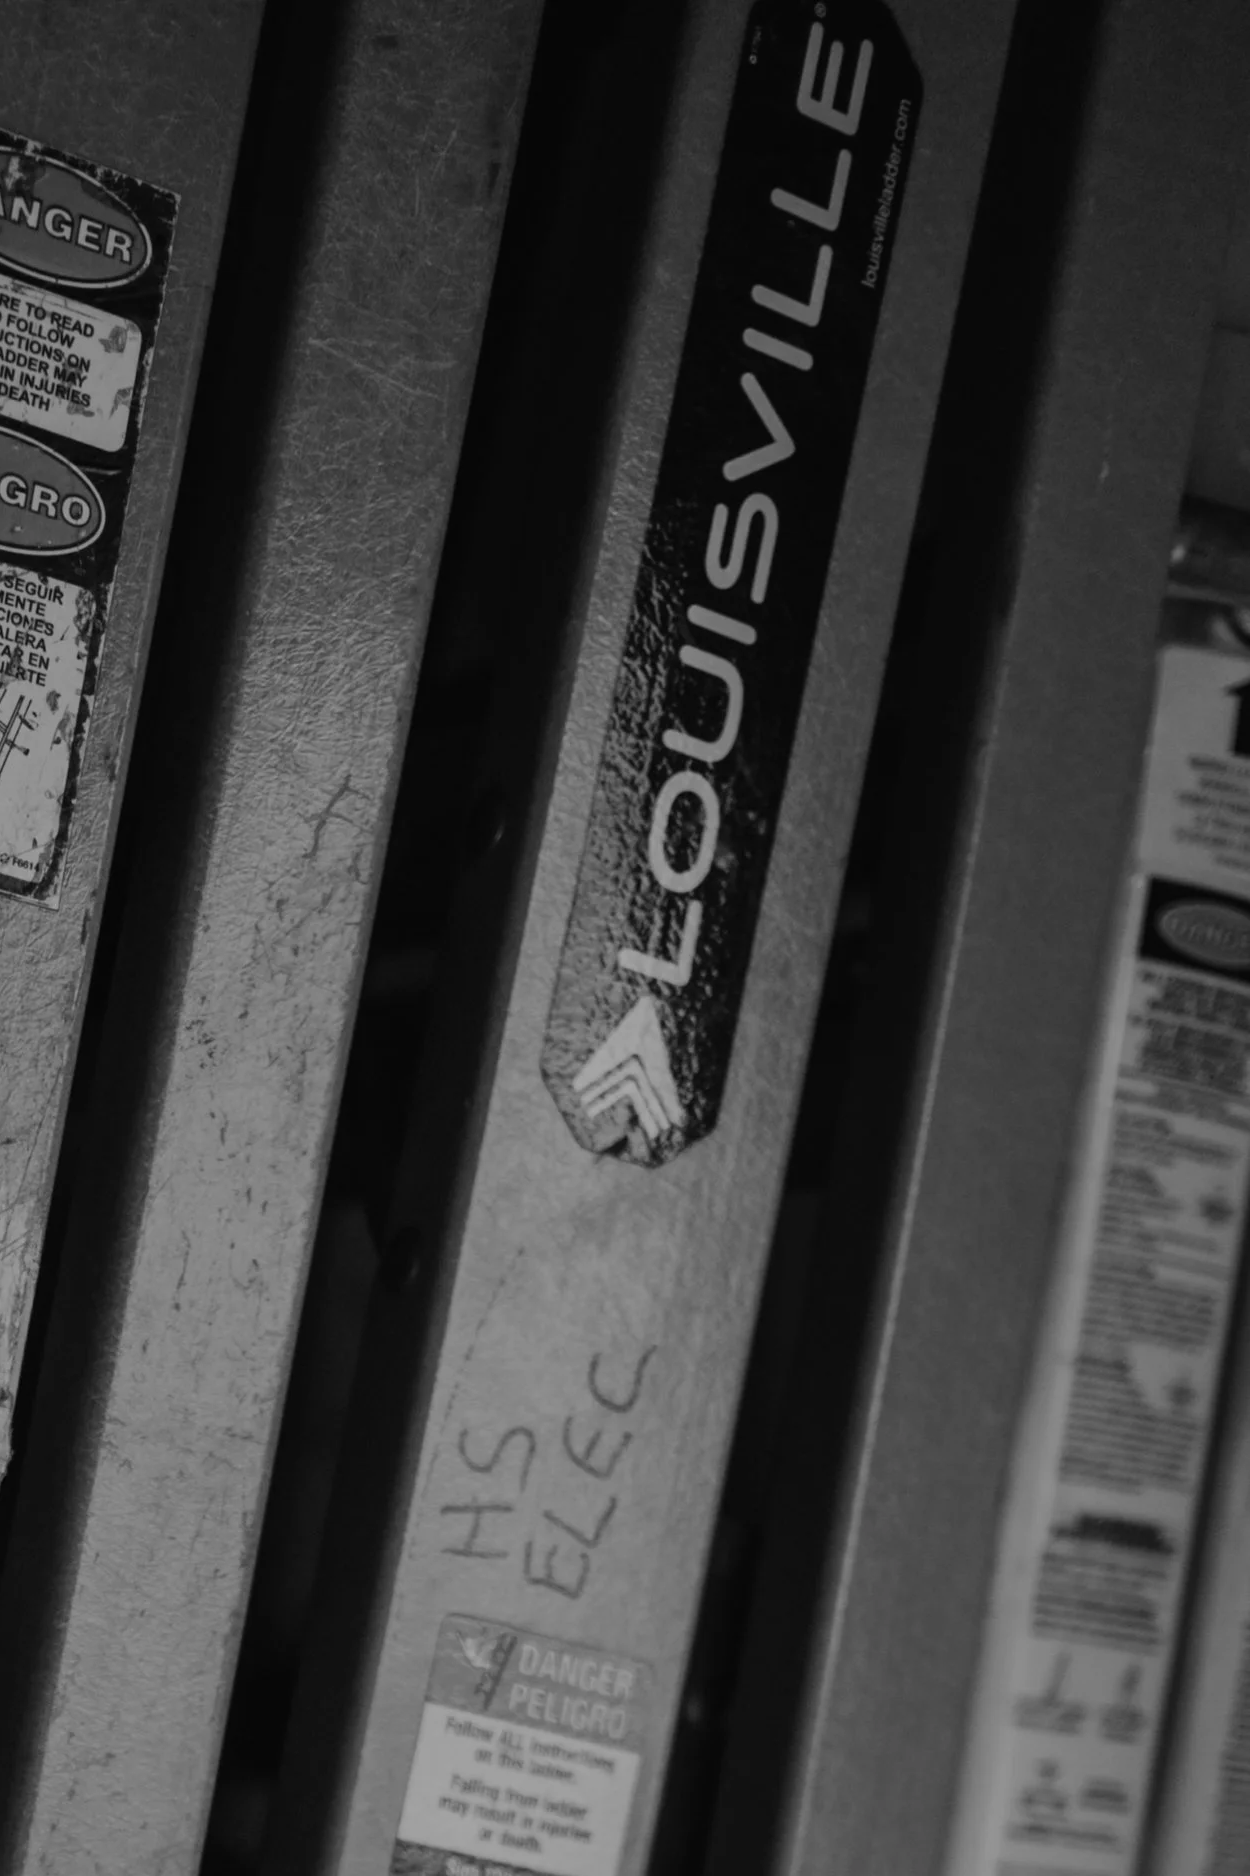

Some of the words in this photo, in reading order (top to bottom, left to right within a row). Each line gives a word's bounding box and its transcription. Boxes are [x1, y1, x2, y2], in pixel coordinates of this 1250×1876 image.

[860, 97, 913, 289] louisvilleladder.com
[5, 314, 75, 349] FOLLOW
[25, 303, 46, 322] TO
[49, 311, 95, 339] READ
[53, 365, 87, 389] MAY
[66, 351, 91, 372] ON
[0, 364, 15, 381] IN
[18, 371, 91, 408] INJURIES
[618, 20, 874, 988] LOUISVILLE
[3, 574, 65, 605] SEGUIR
[27, 651, 50, 670] EN
[523, 1344, 658, 1600] ELEC
[439, 1426, 537, 1559] HS
[516, 1642, 635, 1700] DANGER
[506, 1681, 629, 1740] PELIGRO
[444, 1715, 494, 1743] Follow
[437, 1794, 470, 1816] may
[448, 1773, 500, 1801] Falling
[503, 1787, 539, 1809] from
